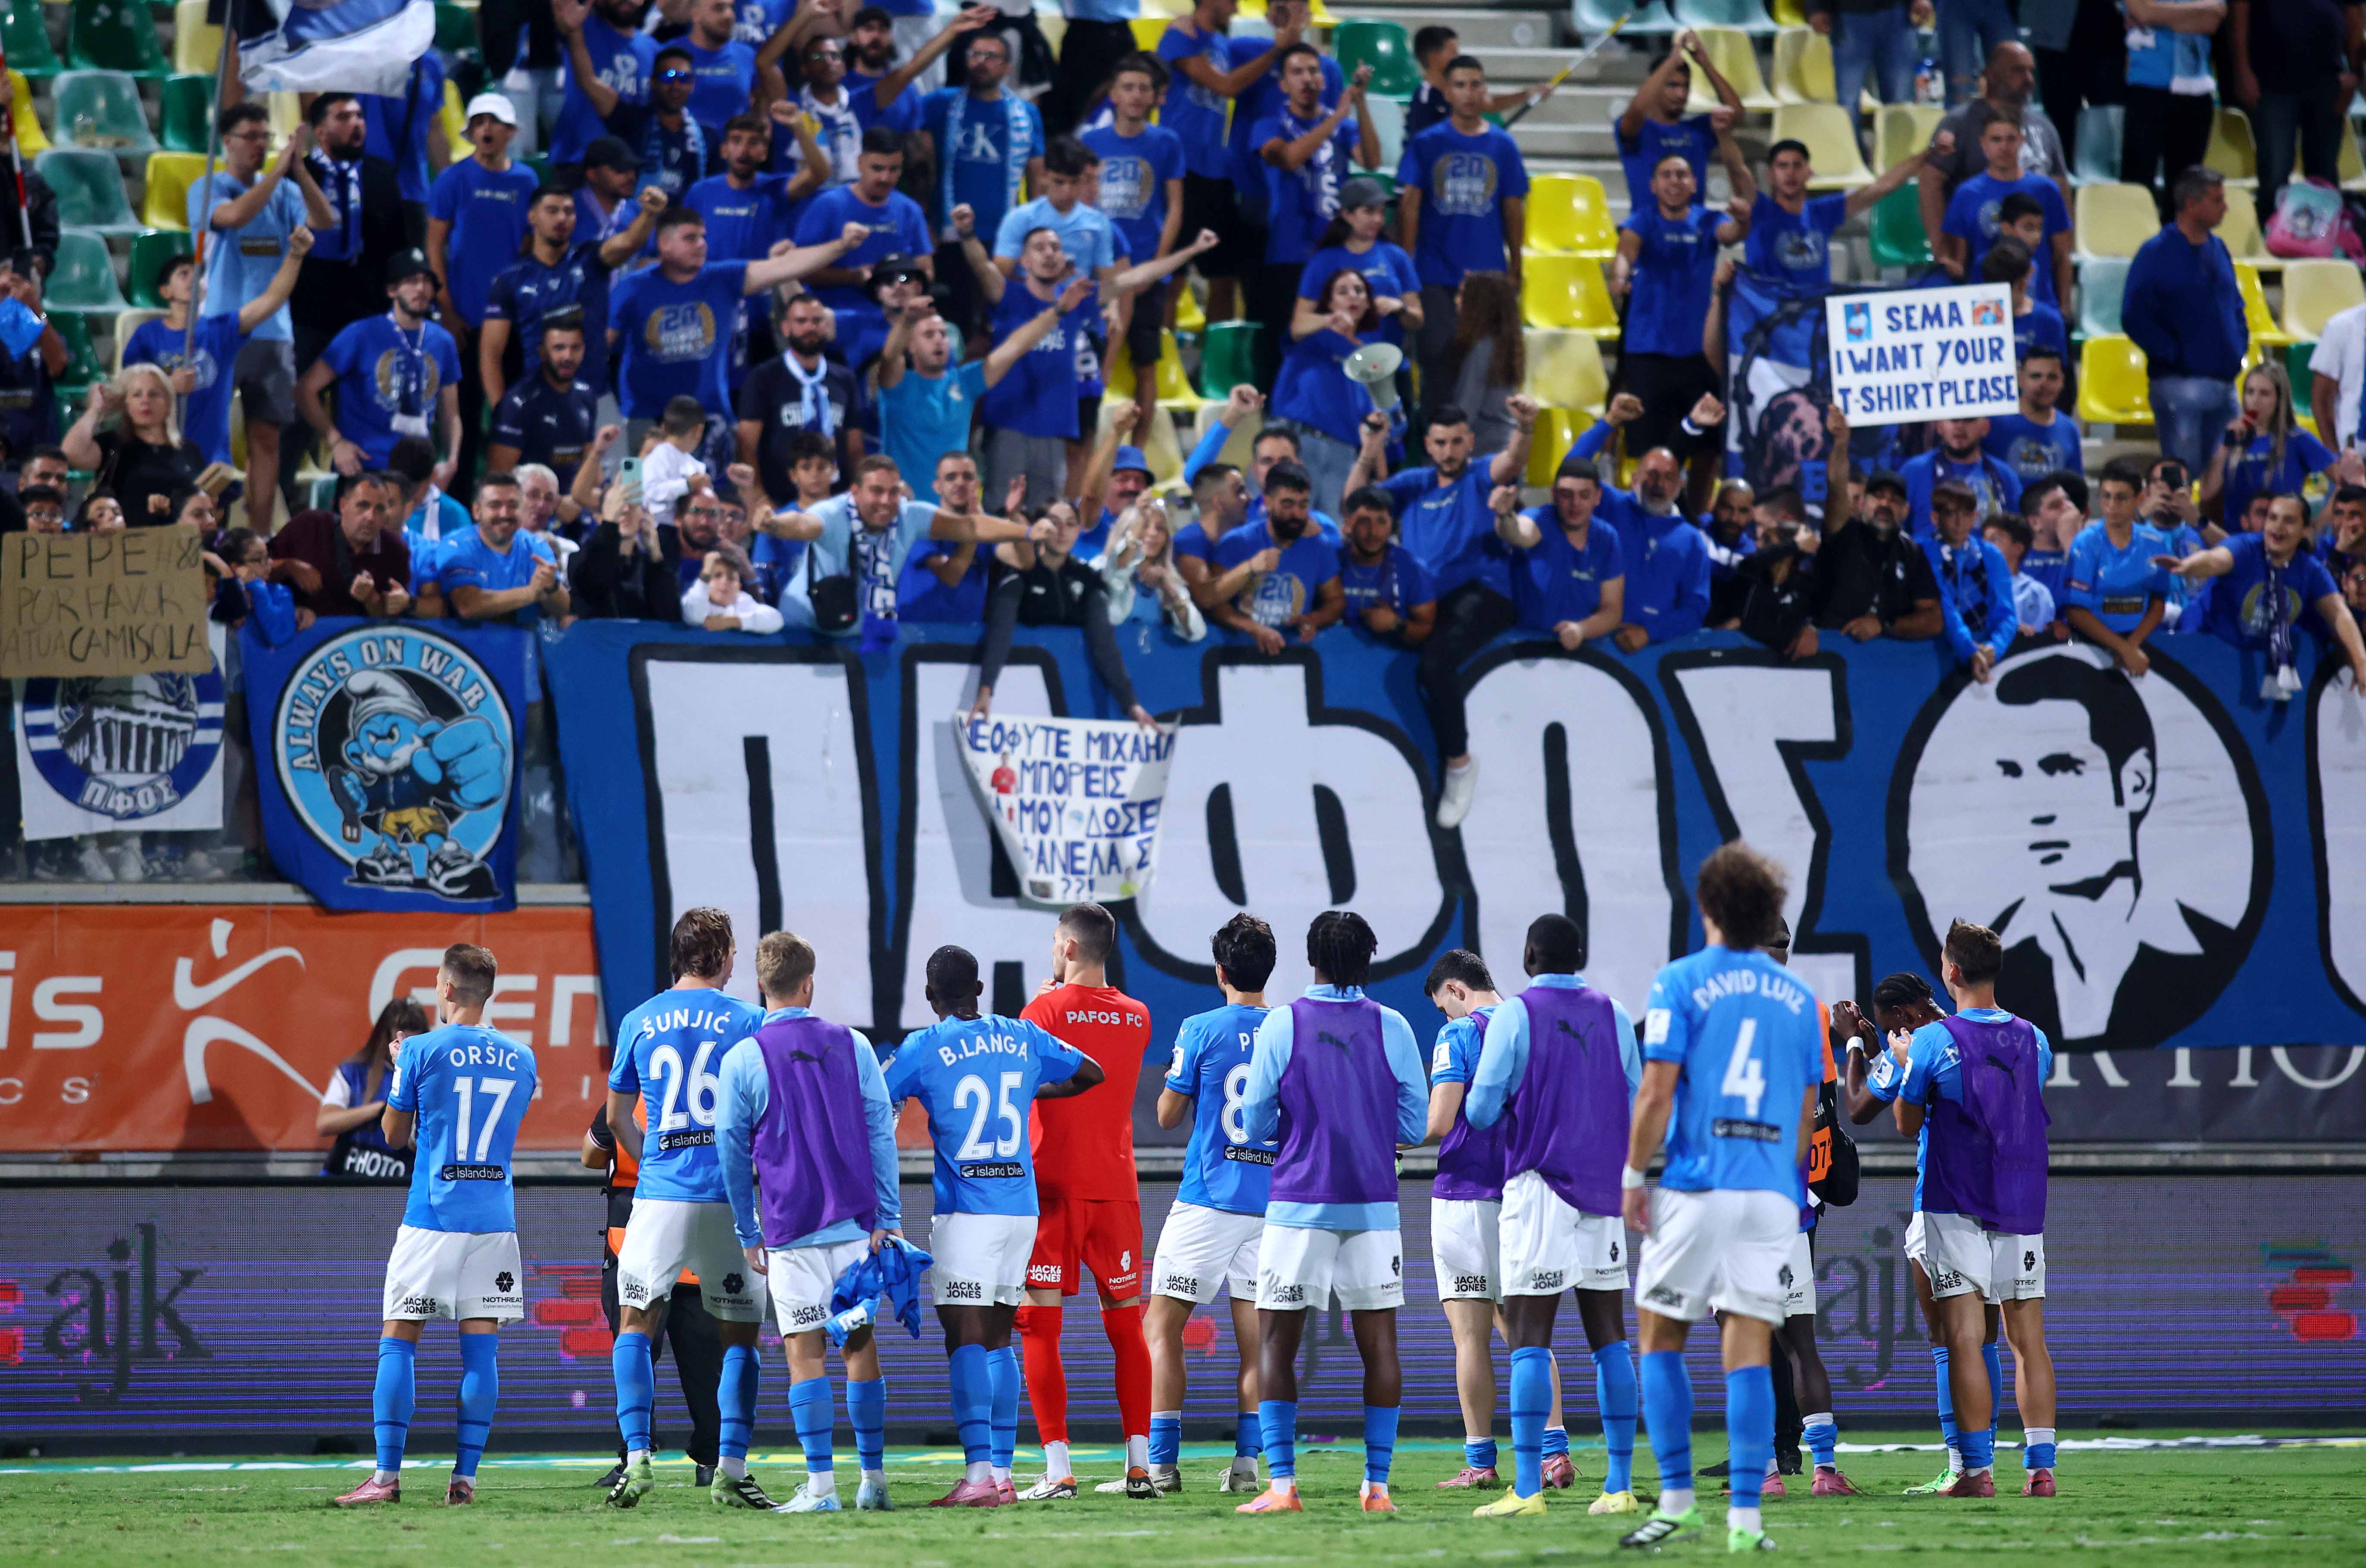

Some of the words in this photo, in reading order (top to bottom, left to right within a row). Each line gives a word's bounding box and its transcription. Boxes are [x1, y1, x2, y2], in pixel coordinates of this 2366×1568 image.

[1886, 301, 1964, 332] SEMA
[1835, 351, 1843, 375] I
[1848, 343, 1923, 374] WANT
[1938, 337, 2005, 368] YOUR
[1838, 382, 1933, 415] T-SHIRT
[1938, 375, 2016, 406] PLEASE
[20, 532, 147, 579] PEPE
[18, 587, 80, 625] POR
[289, 651, 353, 772] ALWAYS
[361, 638, 403, 665] ON
[421, 644, 487, 710] WAR
[1020, 760, 1126, 798] ΜΠΟΡΕΙΣ
[1019, 799, 1066, 835] ΜΟΥ
[1024, 839, 1122, 875] ΑΝΕΛΑ
[1693, 969, 1757, 1012] DAVID
[1761, 973, 1806, 1015] LUIZ
[641, 1008, 731, 1039] ŠUNJIĆ
[1066, 1010, 1121, 1025] PAFOS
[1125, 1013, 1143, 1028] FC
[449, 1040, 518, 1071] ORŠIĆ
[938, 1034, 1027, 1066] B.LANGA
[1721, 1017, 1766, 1117] 4
[649, 1041, 720, 1132] 26
[453, 1077, 517, 1161] 17
[953, 1071, 1023, 1160] 25
[671, 1133, 701, 1147] island
[345, 1147, 406, 1177] PHOTO
[1238, 1149, 1261, 1163] island
[1263, 1153, 1276, 1165] blu
[977, 1166, 1005, 1176] island
[1007, 1165, 1024, 1176] blue
[1030, 1265, 1061, 1274] JACK&
[1030, 1273, 1061, 1282] JONES
[946, 1281, 981, 1290] JACK&
[1166, 1282, 1197, 1295] JONES
[1167, 1275, 1197, 1287] JACK&
[1454, 1276, 1486, 1284] JACK&
[1455, 1284, 1486, 1292] JONES
[625, 1283, 648, 1295] JACK&
[626, 1291, 647, 1303] JONES
[946, 1290, 981, 1298] JONES
[1273, 1284, 1303, 1294] JACK&
[403, 1297, 436, 1306] JACK&
[711, 1296, 753, 1304] NOTHREAT
[1273, 1294, 1303, 1303] JONES
[45, 1223, 209, 1404] ajk
[404, 1305, 436, 1314] JONES
[793, 1303, 824, 1318] JACK&
[794, 1312, 827, 1325] JONES
